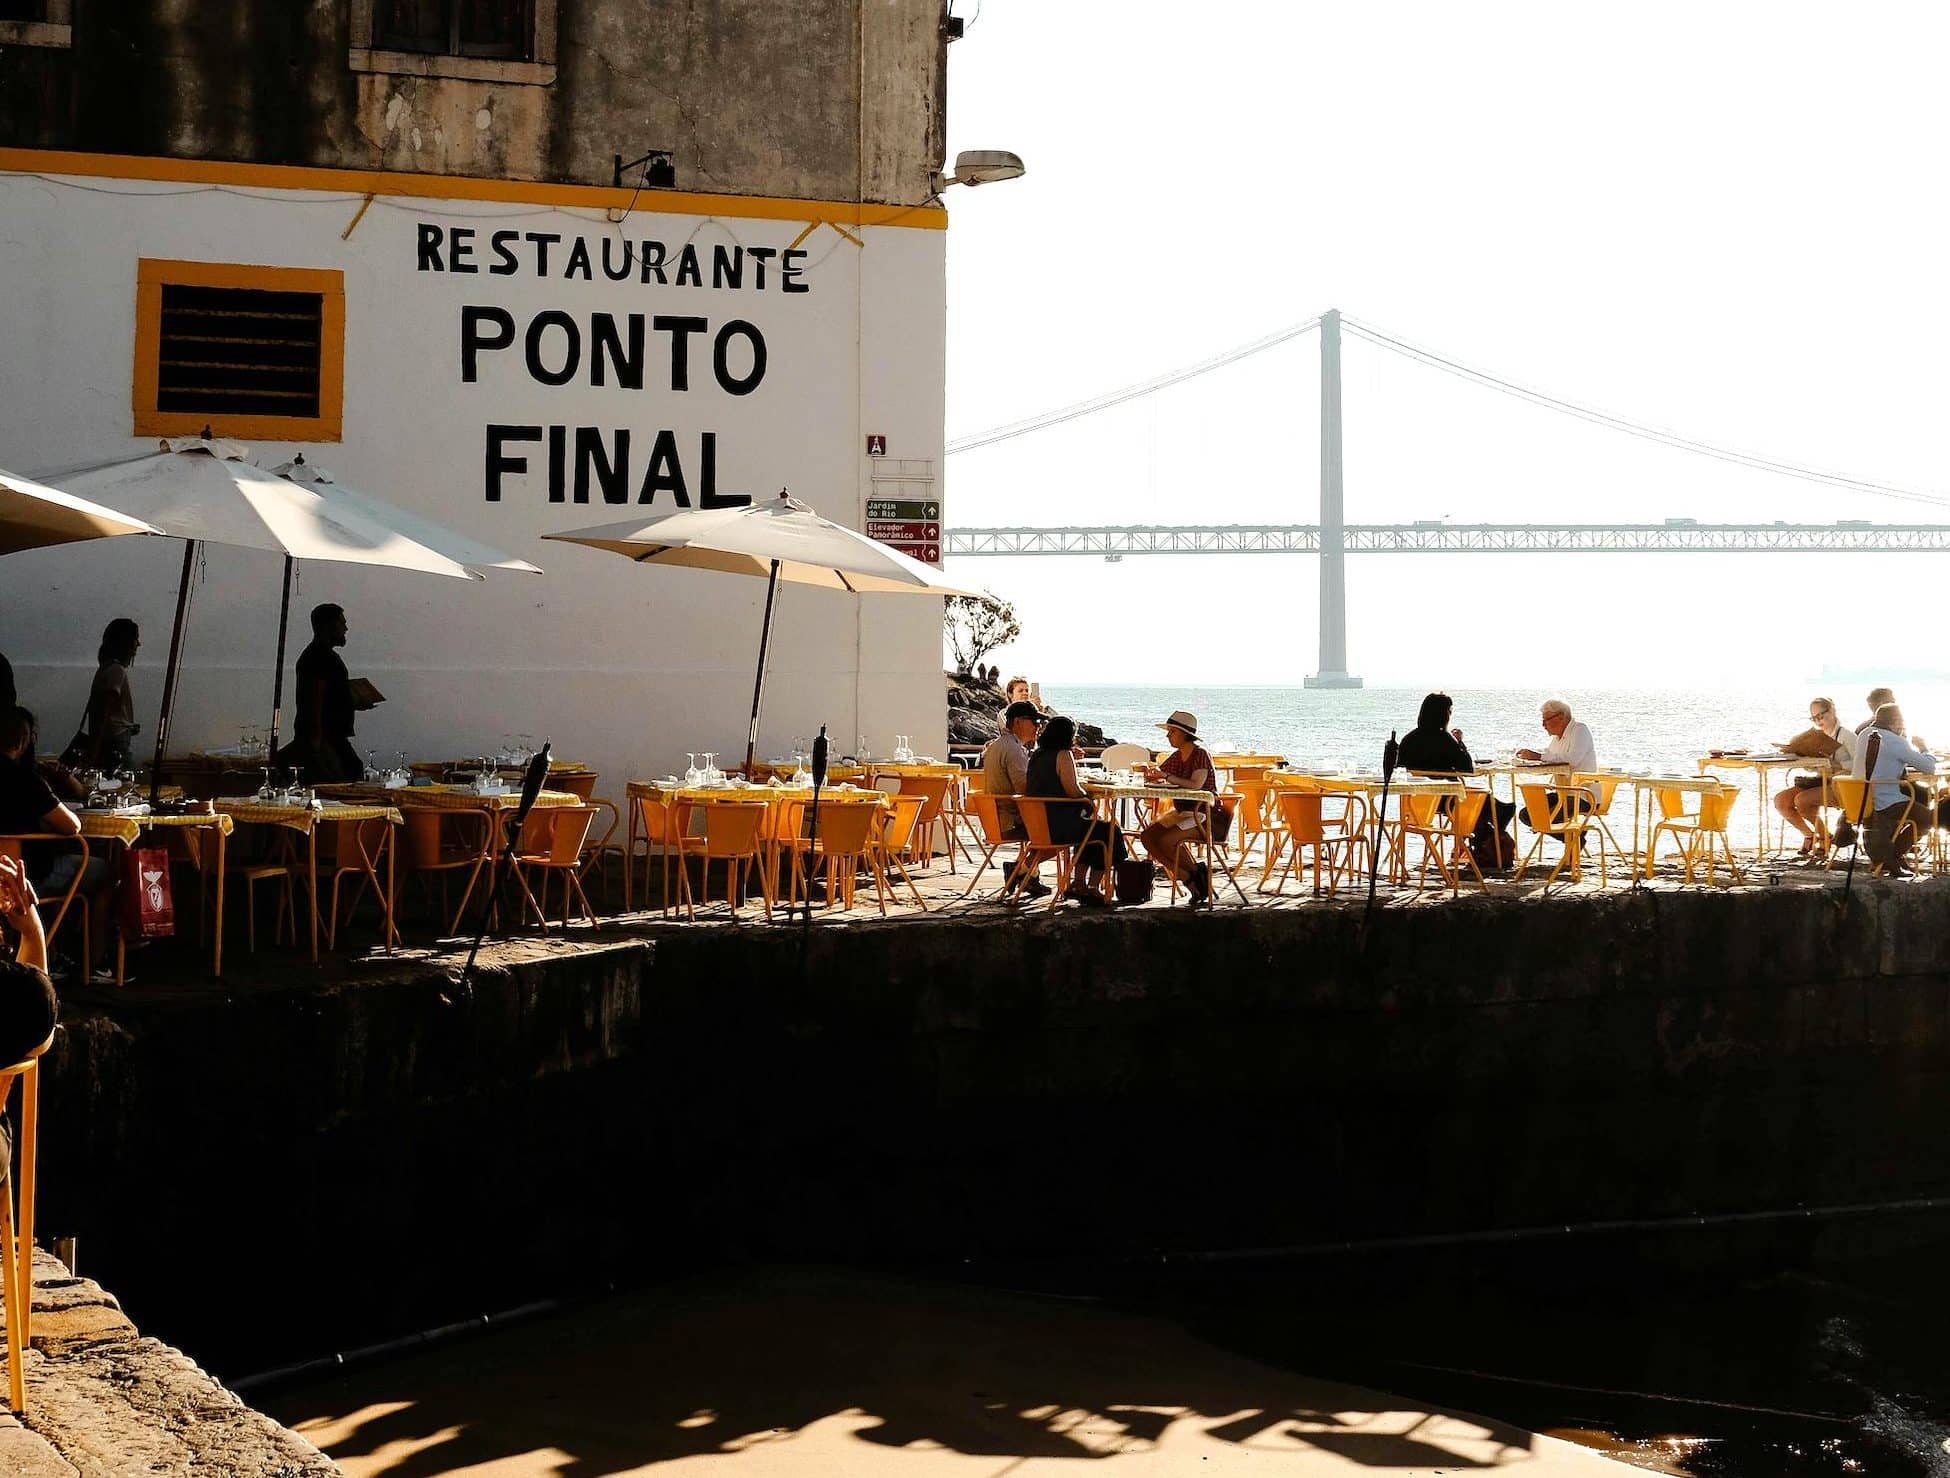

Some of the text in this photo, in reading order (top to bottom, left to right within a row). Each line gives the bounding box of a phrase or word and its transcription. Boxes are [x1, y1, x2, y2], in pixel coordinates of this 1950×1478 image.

[417, 223, 810, 293] RESTAURANTE
[461, 305, 767, 396] PONTO
[485, 423, 752, 510] FINAL
[868, 502, 896, 510] Jardim
[881, 510, 896, 518] Rio
[868, 523, 905, 531] Elevador
